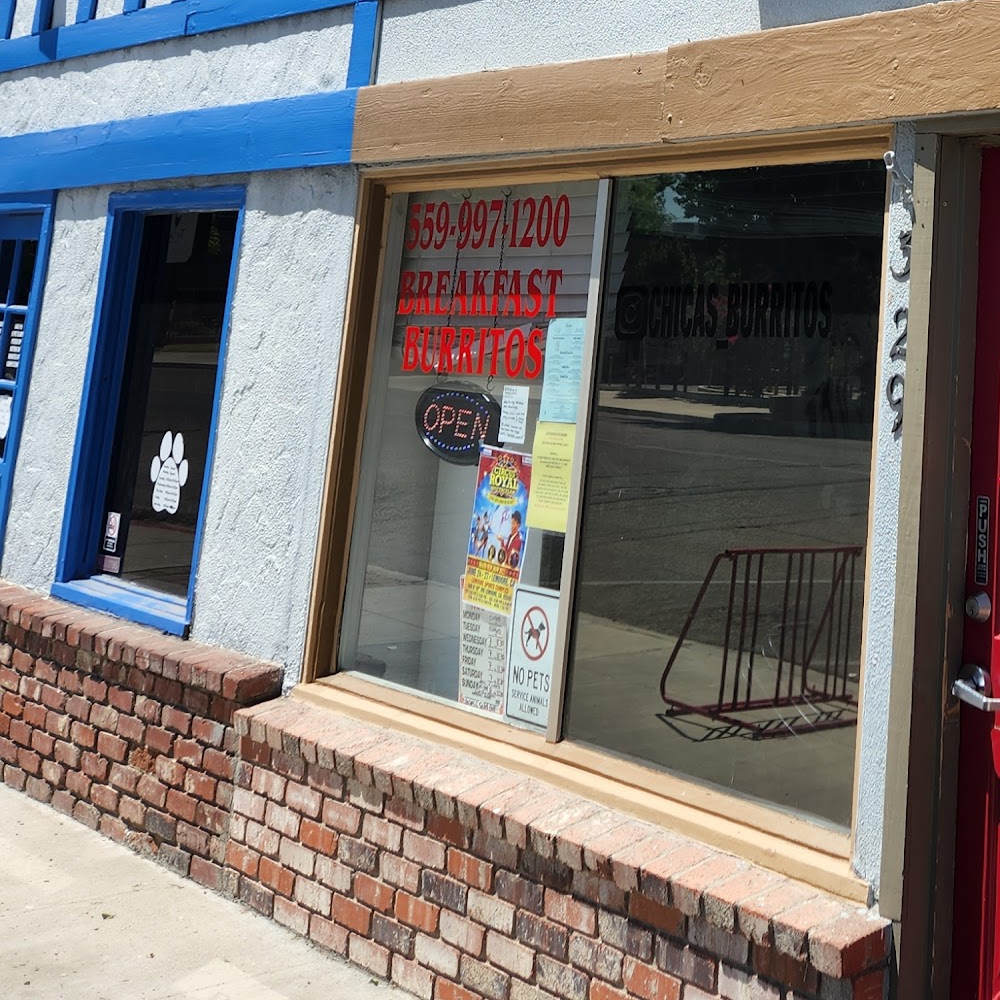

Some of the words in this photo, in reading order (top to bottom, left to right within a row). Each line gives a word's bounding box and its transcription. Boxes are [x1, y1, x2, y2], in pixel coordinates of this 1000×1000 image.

[406, 194, 570, 250] 559-997-1200
[397, 268, 563, 319] BREAKFAST
[402, 325, 544, 380] BURRITOS
[423, 403, 490, 440] OPEN
[489, 474, 519, 489] ROYAL
[977, 503, 988, 563] PUSH
[462, 609, 480, 620] MONDAY
[462, 621, 480, 632] TUESDAY
[462, 633, 487, 646] WEDNESDAY
[462, 644, 484, 657] THURSDAY
[462, 655, 477, 666] FRIDAY
[462, 666, 483, 680] SATURDAY
[512, 665, 524, 685] NO
[526, 670, 550, 693] PETS
[462, 678, 479, 689] SUNDAY
[512, 689, 529, 703] SERVICE
[529, 696, 548, 708] ANIMALS
[519, 705, 539, 717] ALLOWED
